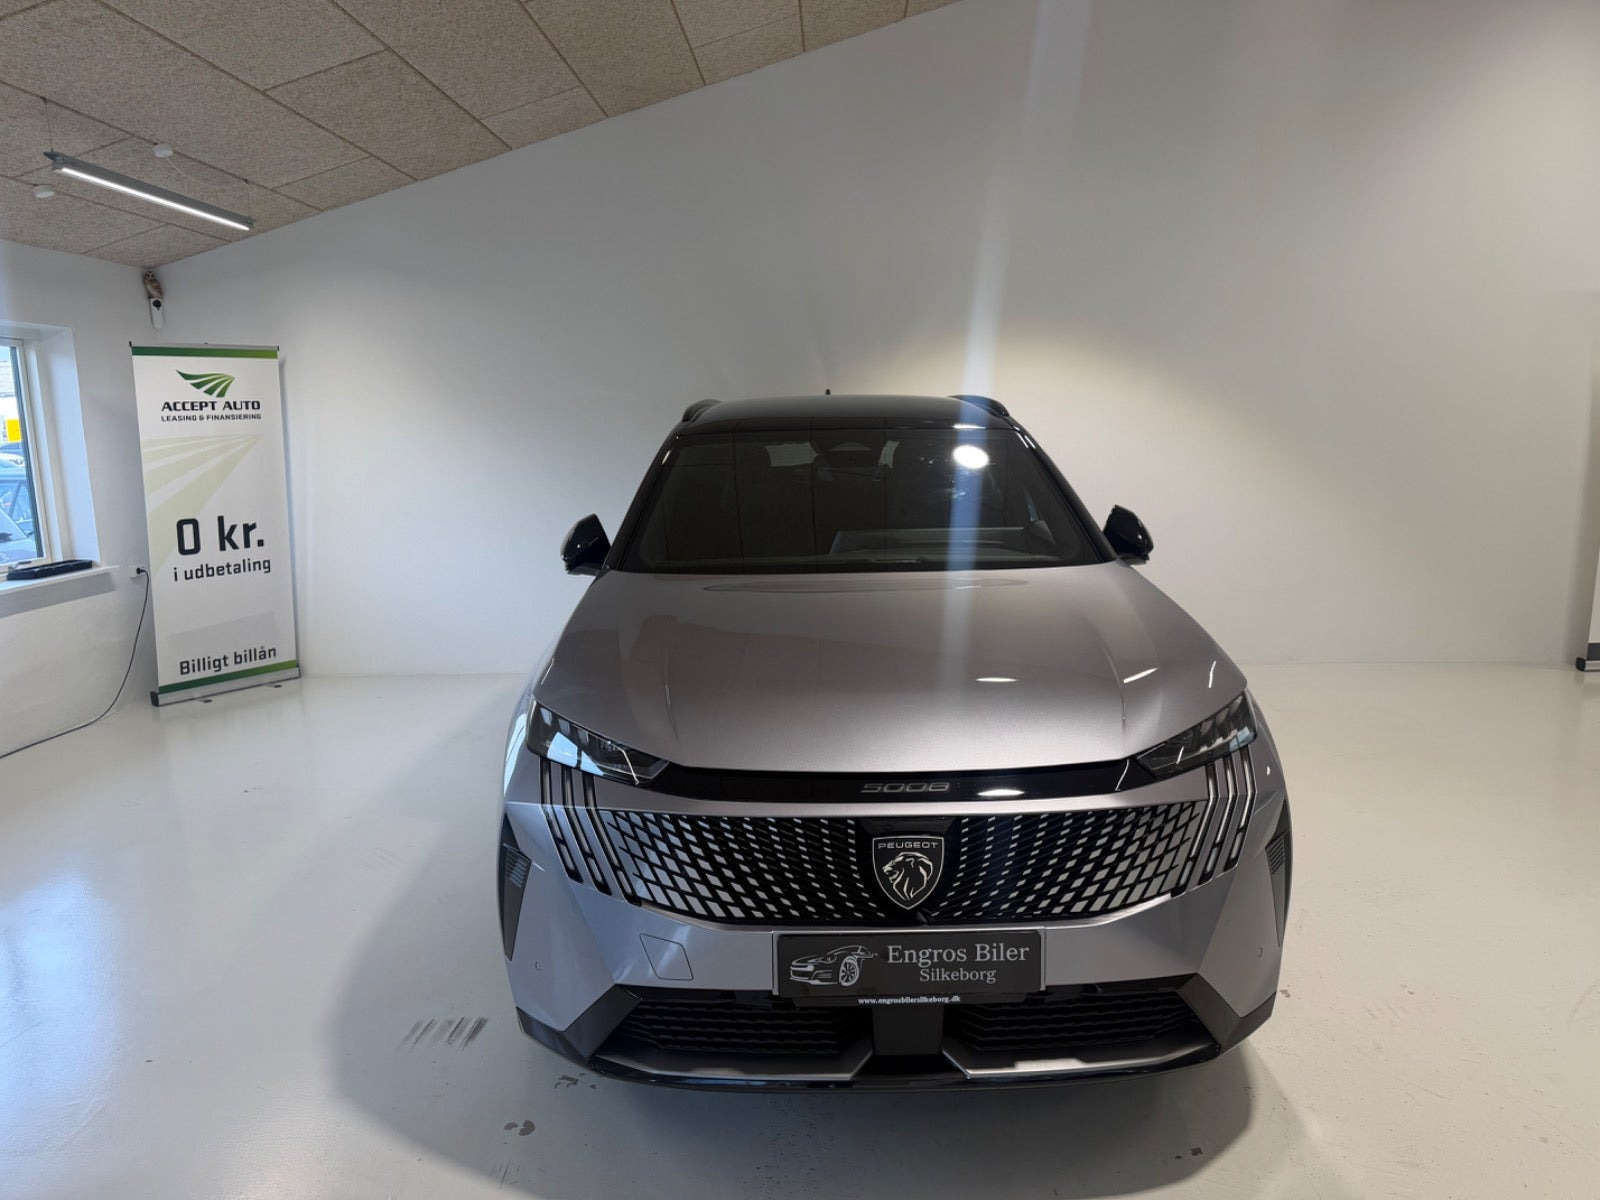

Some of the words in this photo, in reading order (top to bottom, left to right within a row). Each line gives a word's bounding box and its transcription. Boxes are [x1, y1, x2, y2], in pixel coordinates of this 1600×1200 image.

[161, 401, 217, 411] ACCEPT
[222, 401, 261, 411] AUTO
[207, 413, 262, 421] FINANSIERING
[217, 515, 265, 551] kr.
[173, 567, 179, 582] i
[184, 558, 272, 581] udbetaling
[180, 654, 230, 675] Billigt
[233, 646, 277, 665] billån
[860, 782, 950, 793] 5008
[887, 945, 968, 968] Engros
[974, 943, 1030, 961] Biler
[919, 967, 997, 983] Silkeborg
[857, 995, 961, 1004] www.engrosbilersilkeborg.dk
